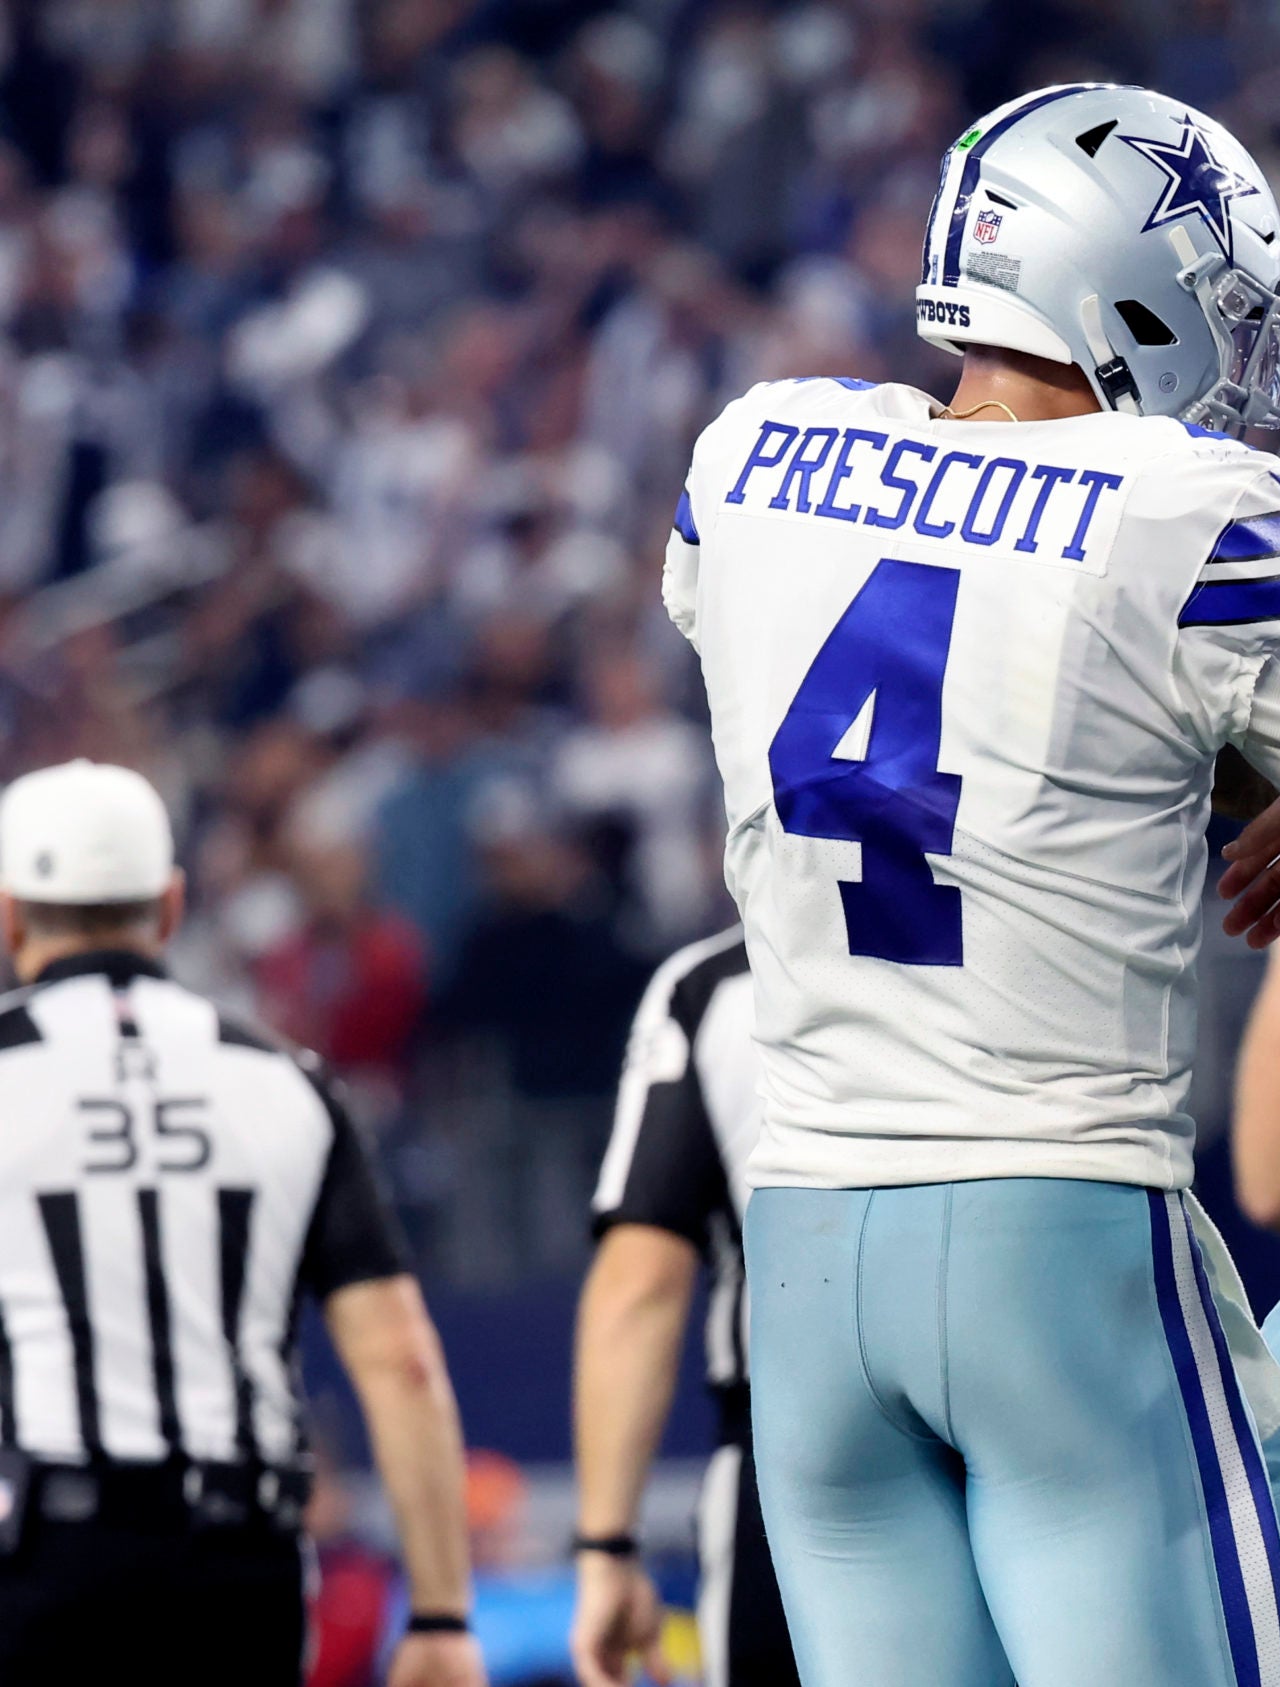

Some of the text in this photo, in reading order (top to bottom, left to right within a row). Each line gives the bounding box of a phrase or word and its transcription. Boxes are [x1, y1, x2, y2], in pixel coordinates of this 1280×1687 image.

[975, 222, 995, 241] NFL
[916, 298, 970, 327] WBOYS
[725, 420, 1122, 561] PRESCOTT
[768, 558, 963, 966] 4
[78, 1098, 213, 1173] 35
